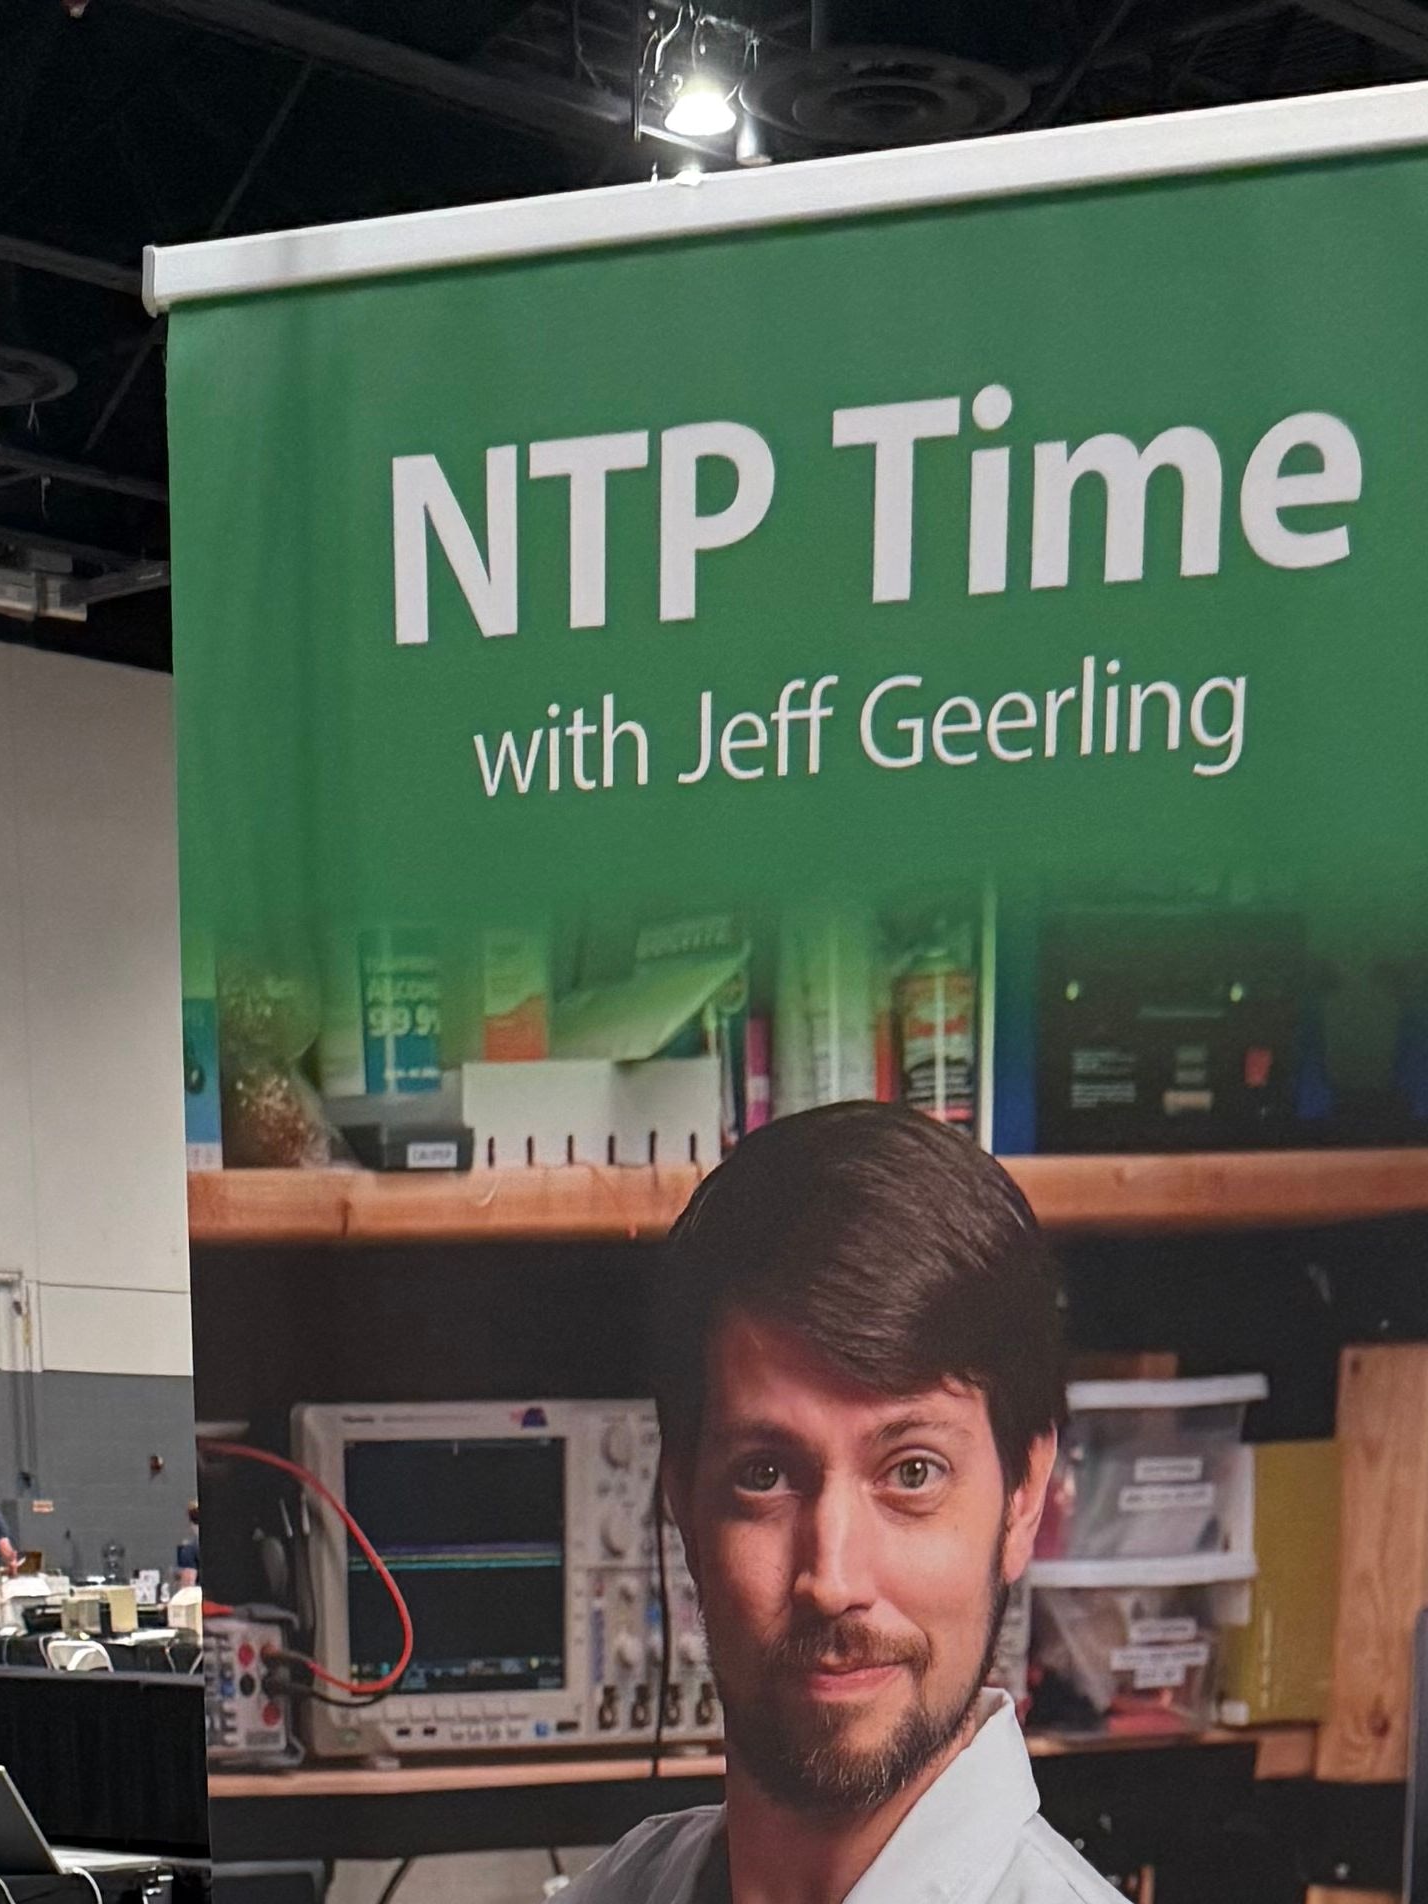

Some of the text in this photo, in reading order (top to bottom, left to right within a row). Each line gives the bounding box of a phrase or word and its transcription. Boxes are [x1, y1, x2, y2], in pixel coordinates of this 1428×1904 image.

[393, 384, 1362, 645] NTP Time
[473, 657, 1247, 798] with Jeff Geerling
